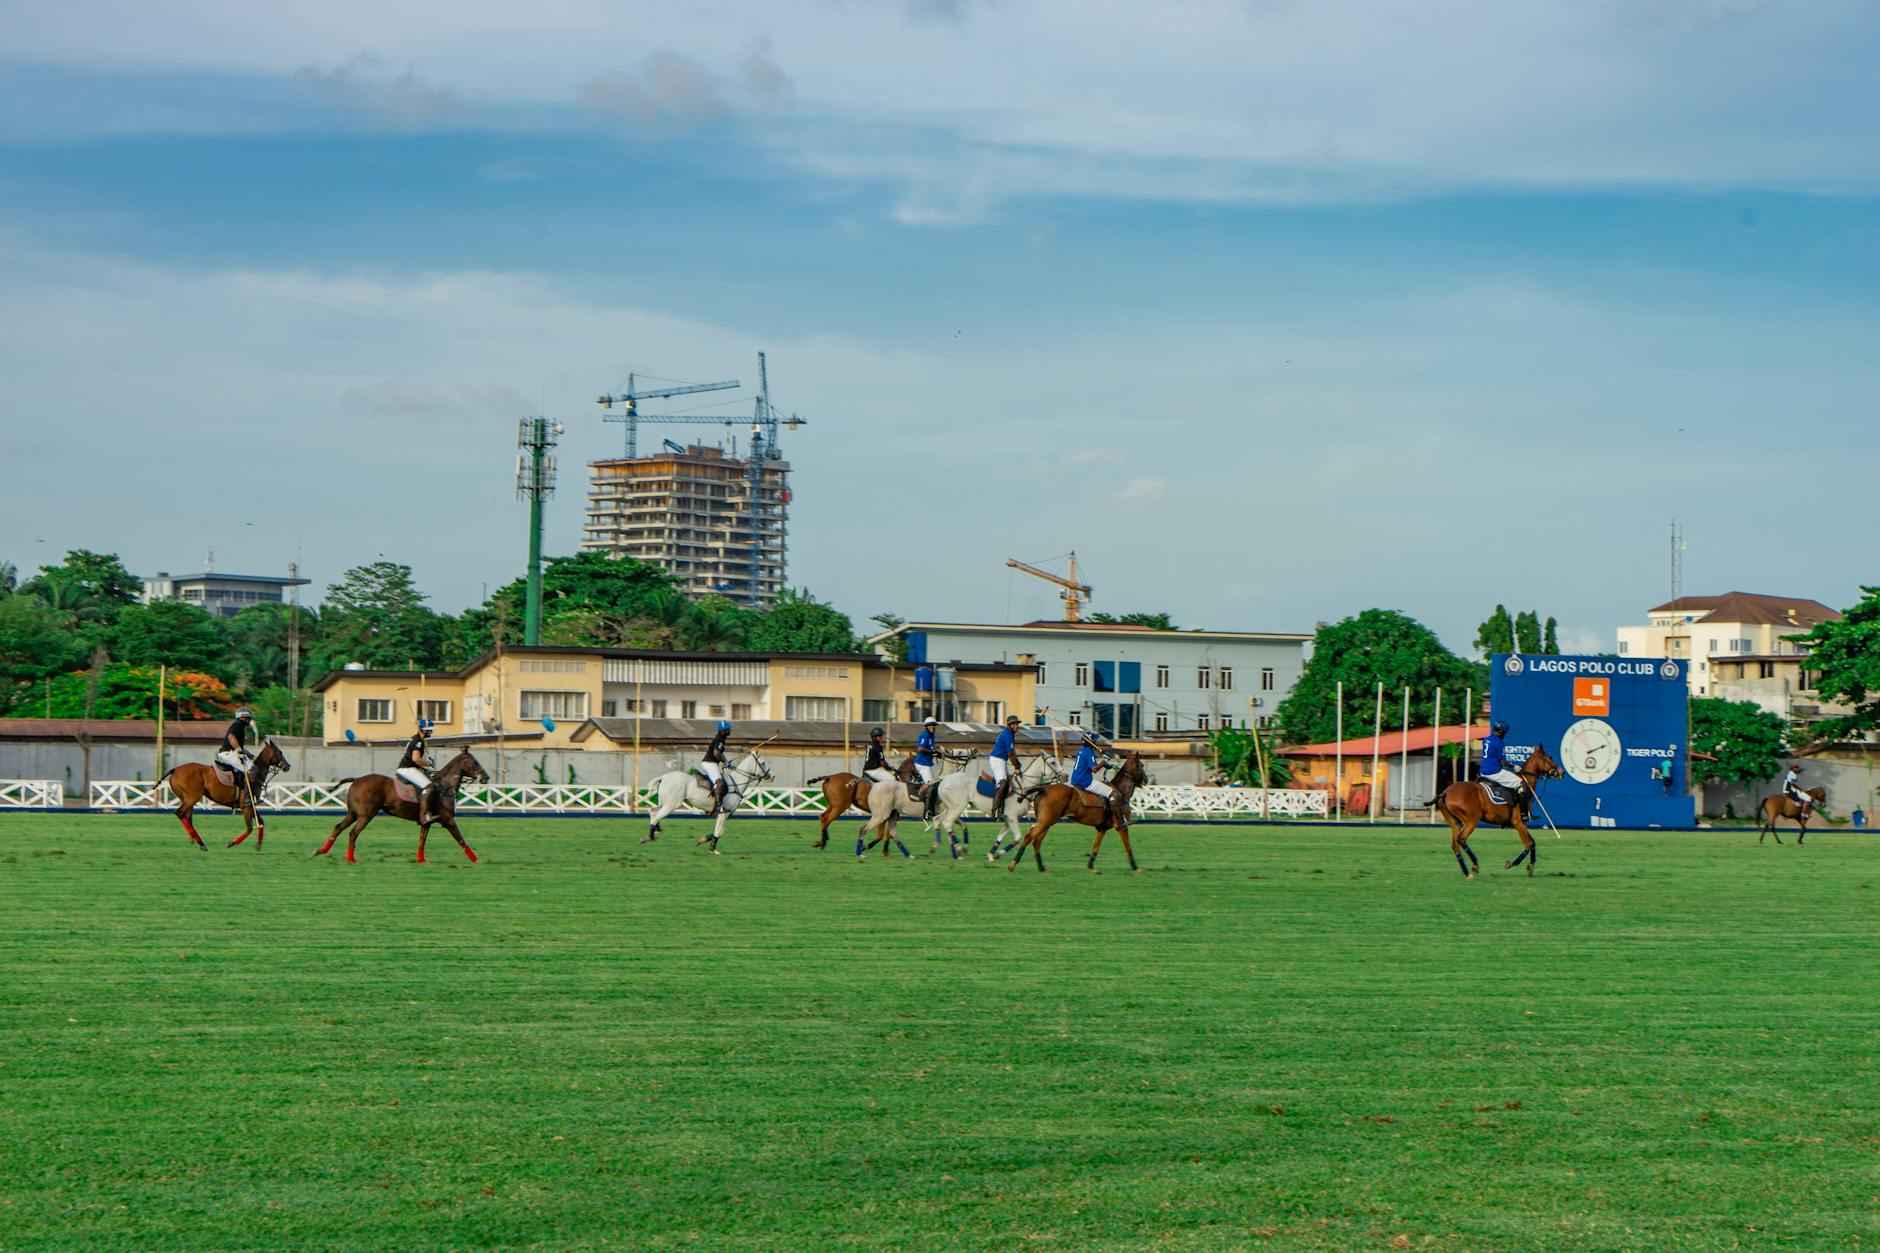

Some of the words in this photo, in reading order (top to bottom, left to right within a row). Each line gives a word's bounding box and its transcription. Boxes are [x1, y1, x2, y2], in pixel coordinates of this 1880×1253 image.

[1530, 660, 1577, 673] LAGOS
[1579, 661, 1615, 674] POLO
[1617, 663, 1654, 675] CLUB
[1650, 749, 1675, 757] POLO
